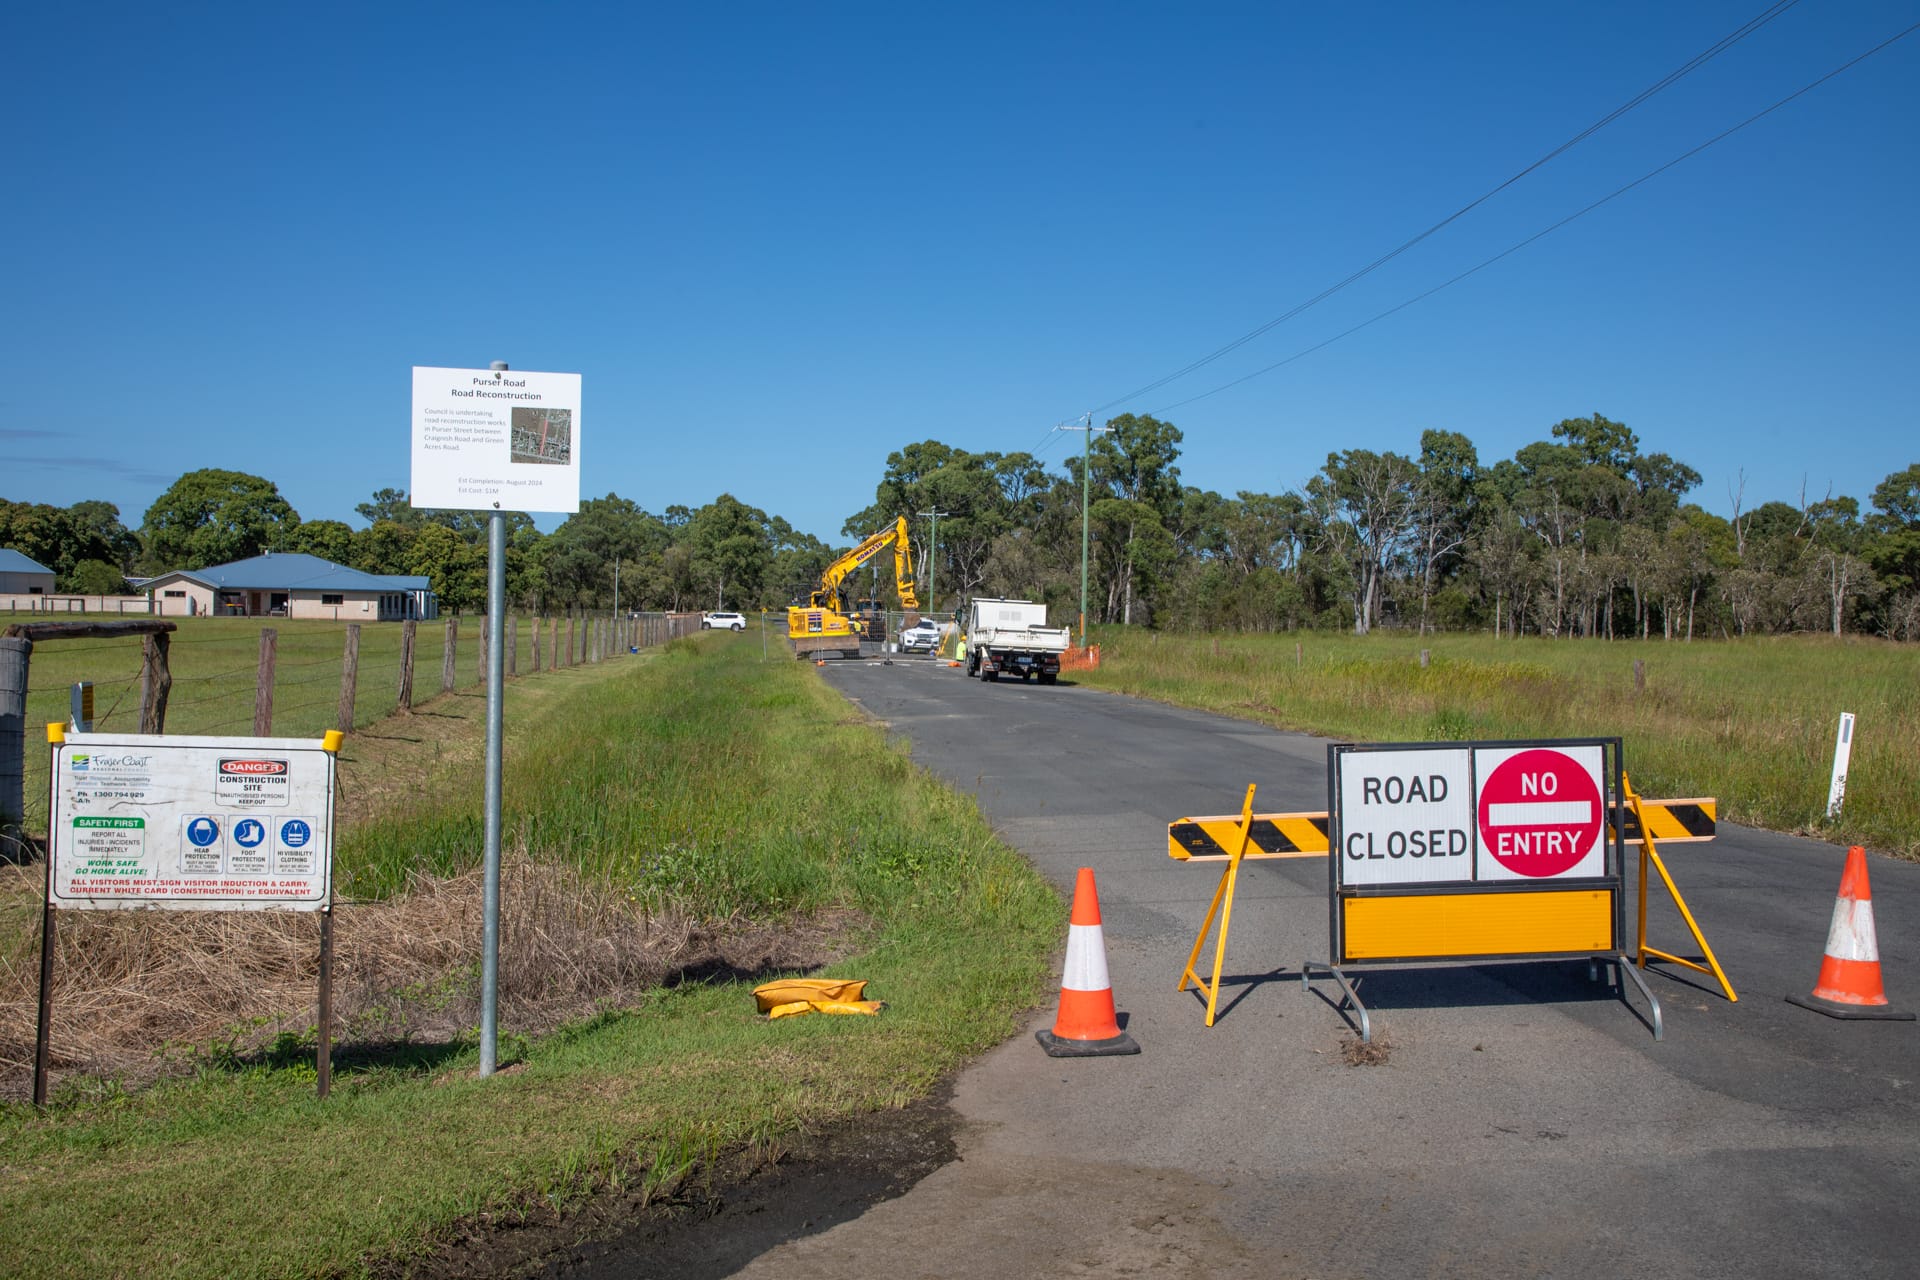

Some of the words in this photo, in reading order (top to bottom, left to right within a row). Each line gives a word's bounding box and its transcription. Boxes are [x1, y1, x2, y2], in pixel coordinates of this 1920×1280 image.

[472, 377, 501, 386] Purser
[503, 379, 526, 387] Road
[451, 389, 474, 397] Road
[476, 390, 542, 400] Reconstruction
[455, 409, 493, 418] undertaking
[440, 418, 486, 426] reconstruction
[424, 435, 453, 443] Craignish
[468, 477, 505, 486] Completion:
[506, 479, 527, 487] August
[856, 541, 883, 561] KOMATSU
[92, 755, 122, 767] Fraser
[122, 755, 152, 767] Coast
[228, 763, 279, 772] DANGER
[219, 776, 287, 784] CONSTRUCTION
[1521, 771, 1558, 796] NO
[1362, 774, 1449, 805] ROAD
[79, 819, 113, 827] SAFETY
[113, 820, 139, 828] FIRST
[1345, 828, 1468, 861] CLOSED
[1497, 830, 1584, 857] ENTRY
[87, 859, 114, 867] WORK
[75, 867, 89, 875] GO
[183, 879, 218, 887] VISITOR
[69, 886, 111, 894] CURRENT
[170, 887, 245, 896] (CONSTRUCTION)
[258, 888, 312, 896] EQUIVALENT
